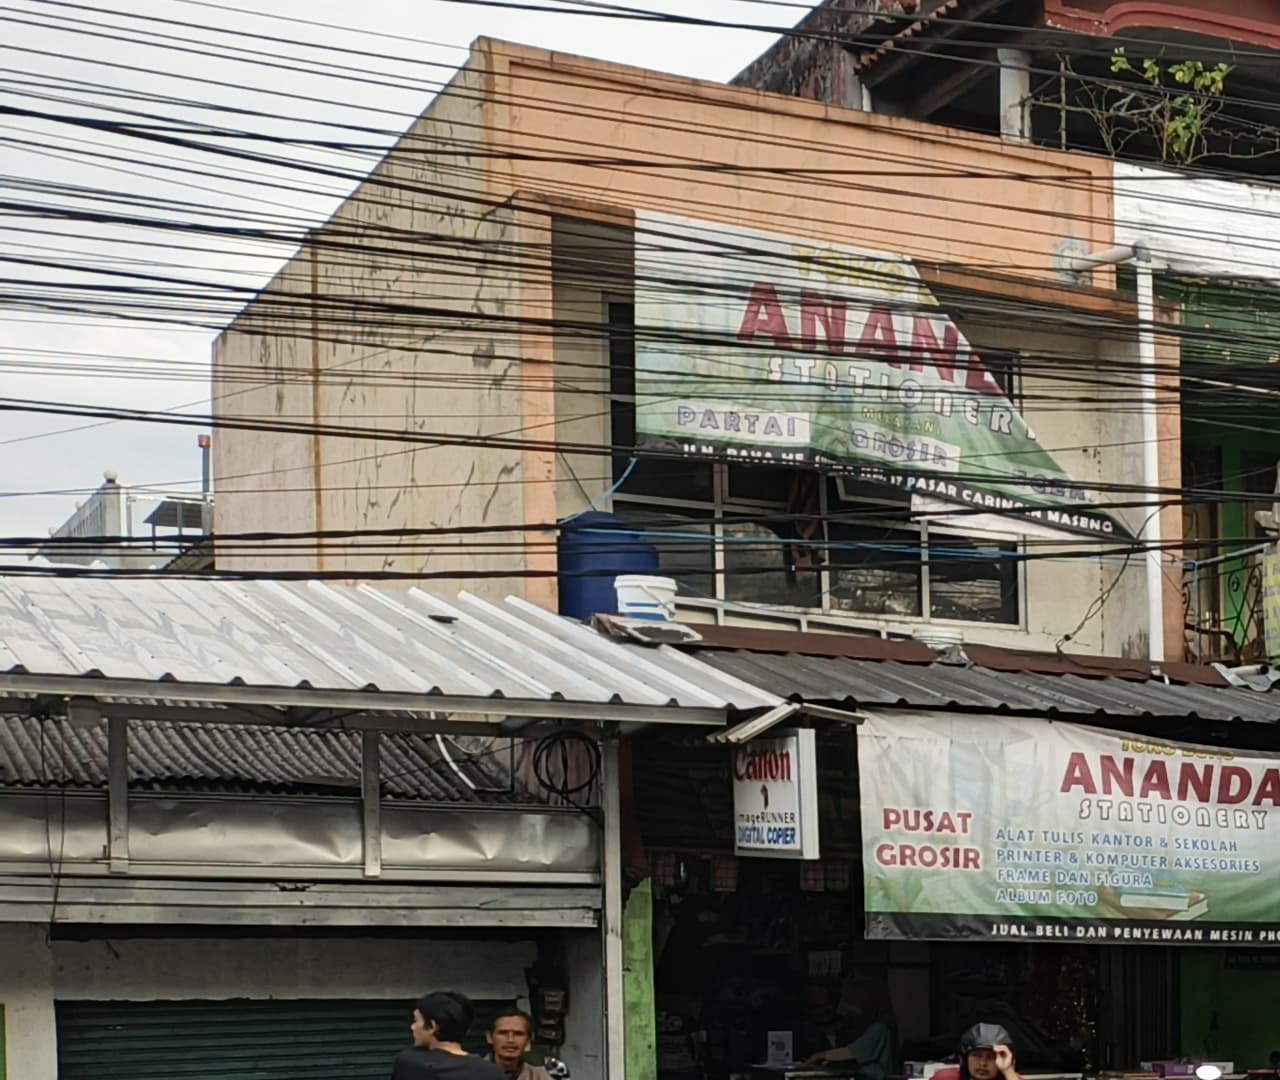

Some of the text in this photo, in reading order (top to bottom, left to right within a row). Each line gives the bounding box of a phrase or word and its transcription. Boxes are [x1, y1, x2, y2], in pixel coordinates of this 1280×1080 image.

[677, 405, 797, 437] PARTAI
[851, 427, 949, 468] GROSIR
[907, 476, 957, 498] PASAR
[1047, 510, 1114, 533] MASENG
[733, 748, 792, 782] Canon
[882, 807, 973, 834] PUSAT
[1078, 797, 1269, 831] STATIONERY
[767, 826, 796, 844] COPIER
[995, 828, 1238, 852] ALAT TULIS KANTOR & SEKOLAH
[875, 843, 982, 870] GROSIR
[996, 849, 1260, 872] PRINTER & KOMPUTER AKSESORIES
[996, 868, 1152, 887] FRAME DAN FIGURA
[996, 889, 1097, 905] ALBUM FOTO
[991, 924, 1028, 937] JUAL
[1035, 925, 1069, 937] BELI
[1076, 926, 1107, 938] DAN
[1114, 926, 1203, 940] PENYEWAAN
[1209, 928, 1252, 941] MESIN
